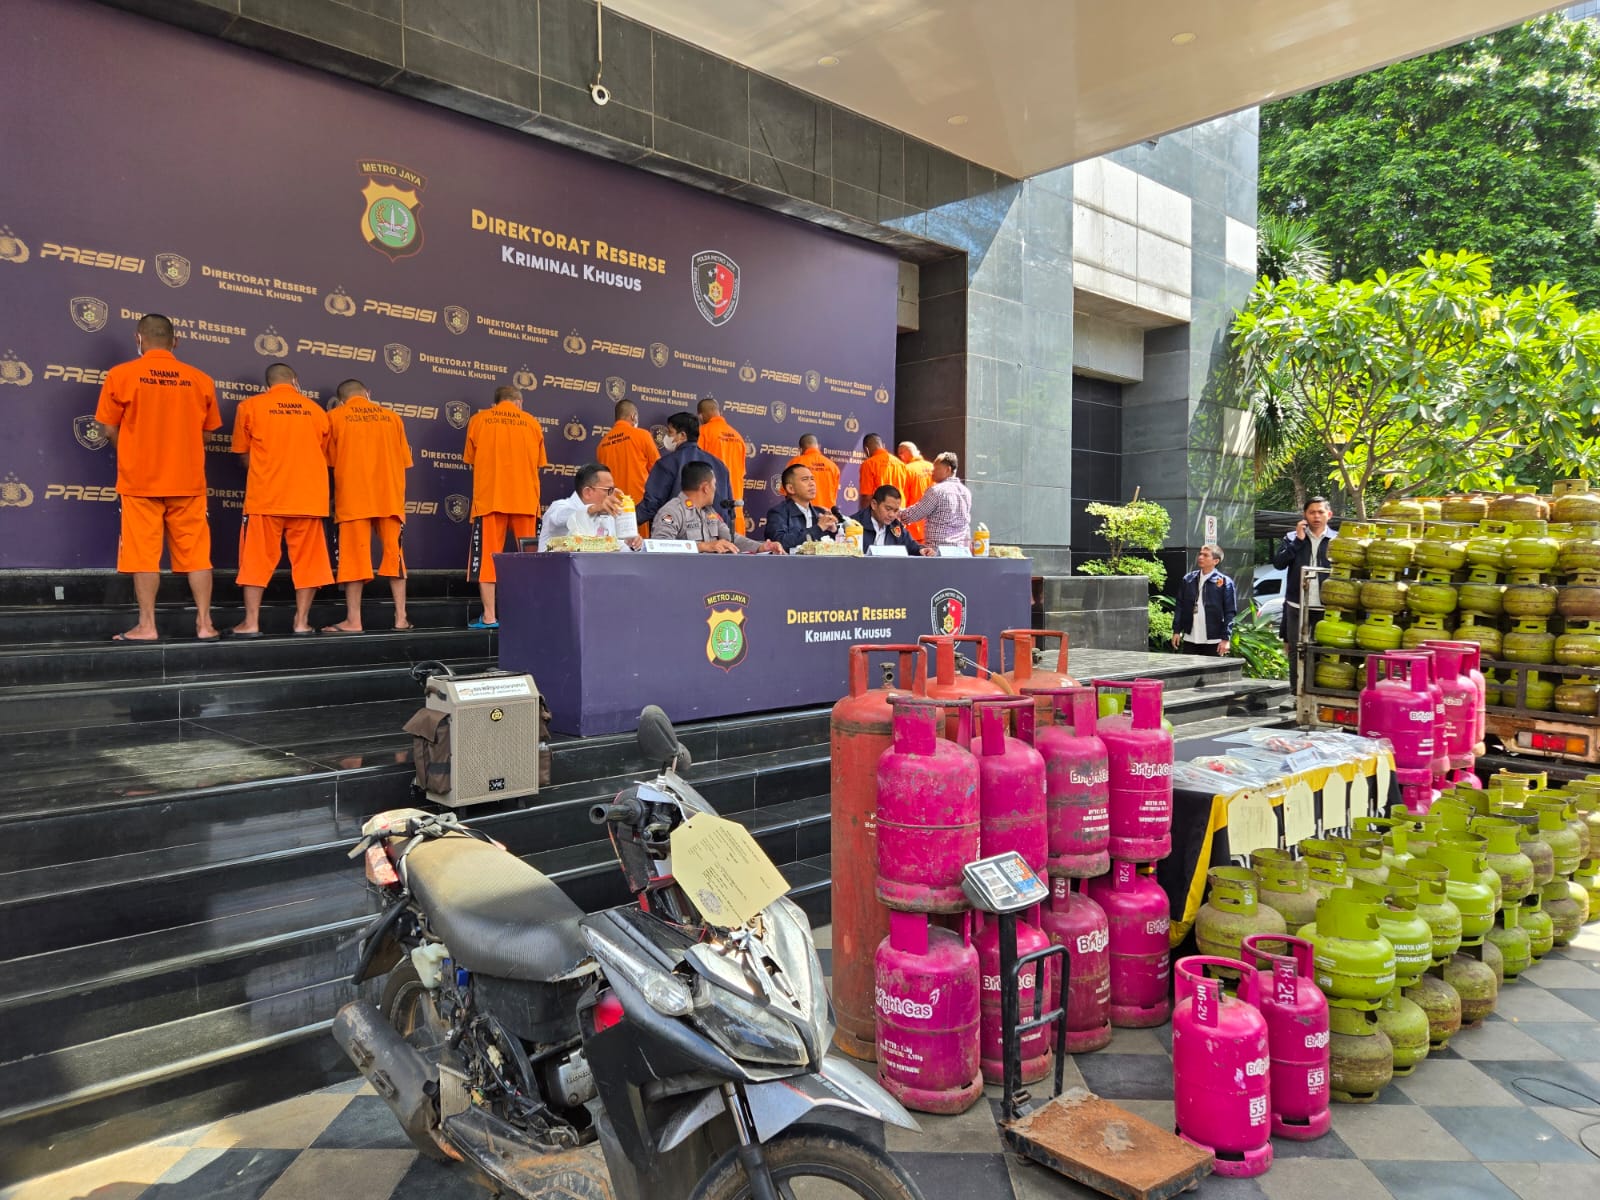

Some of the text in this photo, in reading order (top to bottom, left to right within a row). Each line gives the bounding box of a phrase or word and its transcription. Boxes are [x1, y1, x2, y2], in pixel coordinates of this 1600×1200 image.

[362, 163, 422, 186] METRO JAYA
[471, 208, 667, 275] DIREKTORAT RESERSE
[40, 243, 146, 274] PRESISI
[501, 245, 642, 292] KRIMINAL KHUSUS
[202, 265, 318, 296] DIREKTORAT RESERSE
[219, 281, 303, 303] KRIMINAL KHUSUS
[363, 299, 438, 324] PRESISI
[121, 308, 194, 330] DIRORAT
[198, 320, 247, 336] RESERSE
[477, 315, 559, 338] DIREKTORAT RESERSE
[296, 339, 377, 363] PRESISI
[591, 339, 646, 359] PRESISI
[419, 352, 509, 374] DIREKTORAT RESERSE
[140, 377, 157, 386] POLDA
[158, 378, 177, 387] METRO
[149, 369, 180, 378] TAHANAN
[760, 369, 802, 385] PRESISI
[543, 374, 601, 394] PRESISI
[723, 400, 768, 417] PRESISI
[45, 484, 119, 502] PRES
[206, 487, 244, 498] DIREKT
[404, 501, 438, 515] SISI
[707, 594, 746, 605] METRO JAYA
[787, 606, 907, 624] DIREKTORAT RESERSE
[805, 627, 892, 643] KRIMINAL KHUSUS
